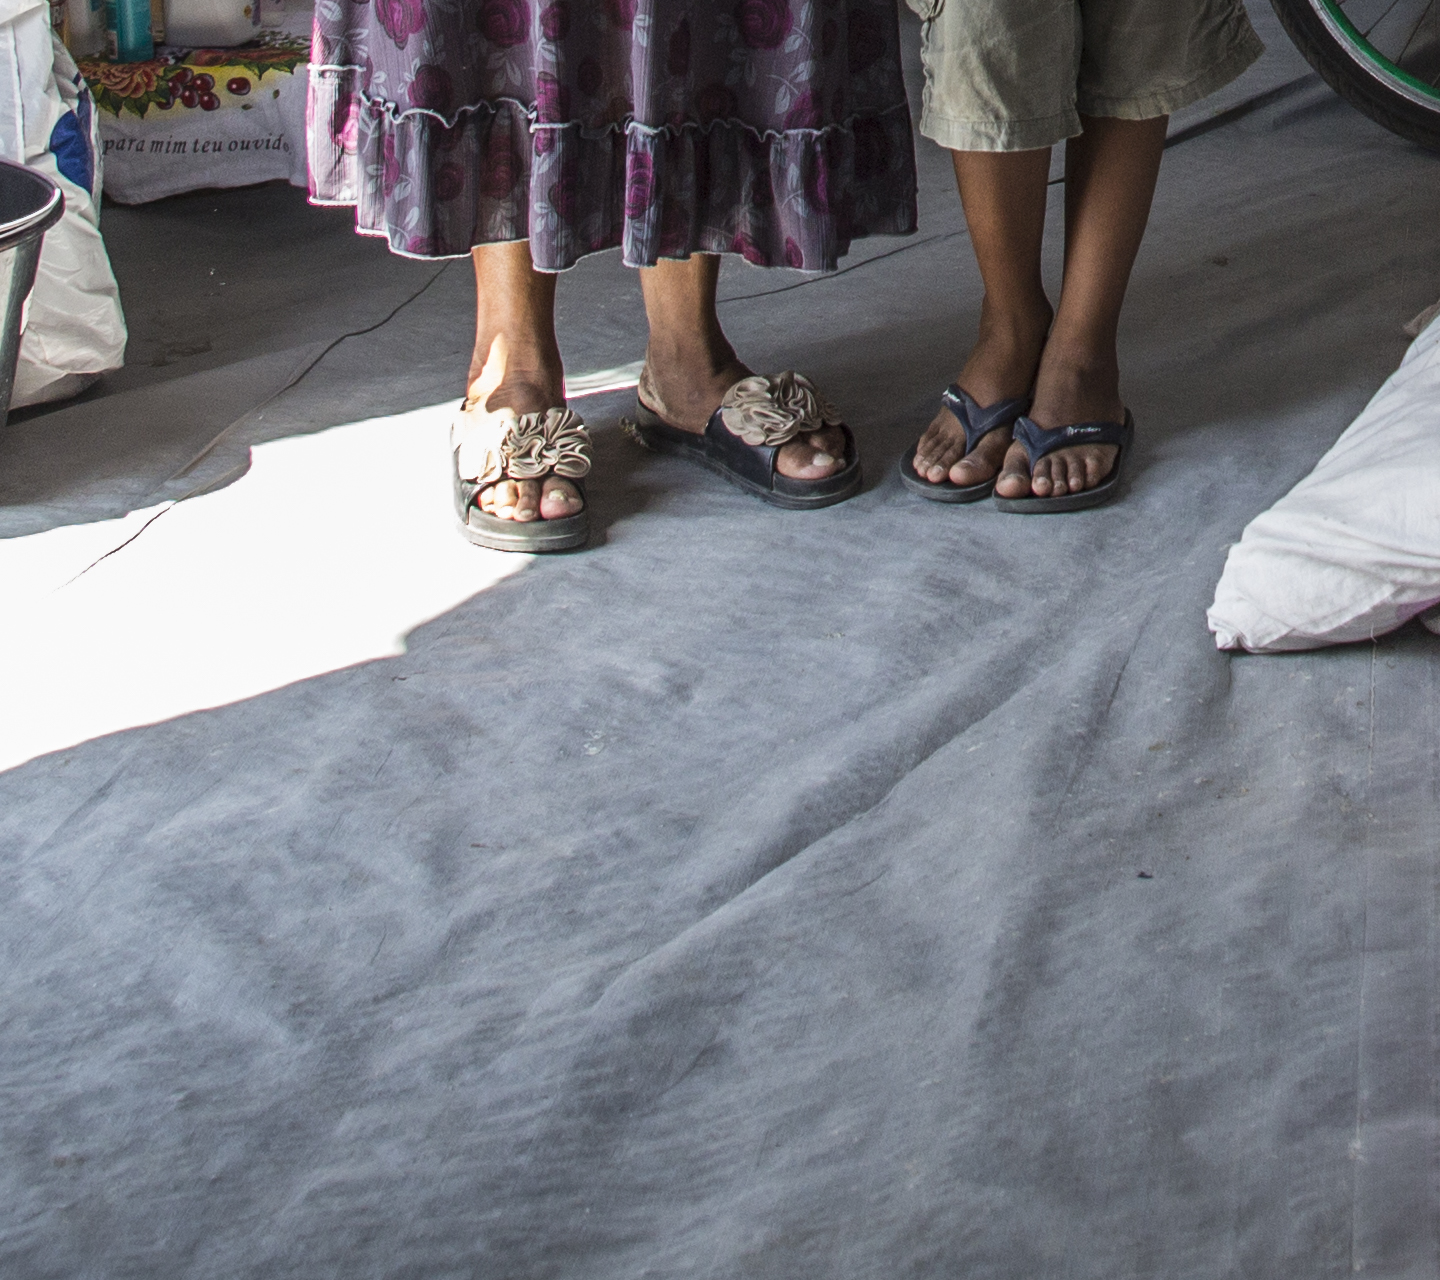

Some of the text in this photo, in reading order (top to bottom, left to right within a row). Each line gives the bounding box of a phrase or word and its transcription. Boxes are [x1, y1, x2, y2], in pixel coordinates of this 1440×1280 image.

[103, 137, 144, 156] para
[149, 135, 187, 154] mim
[192, 137, 223, 154] teu
